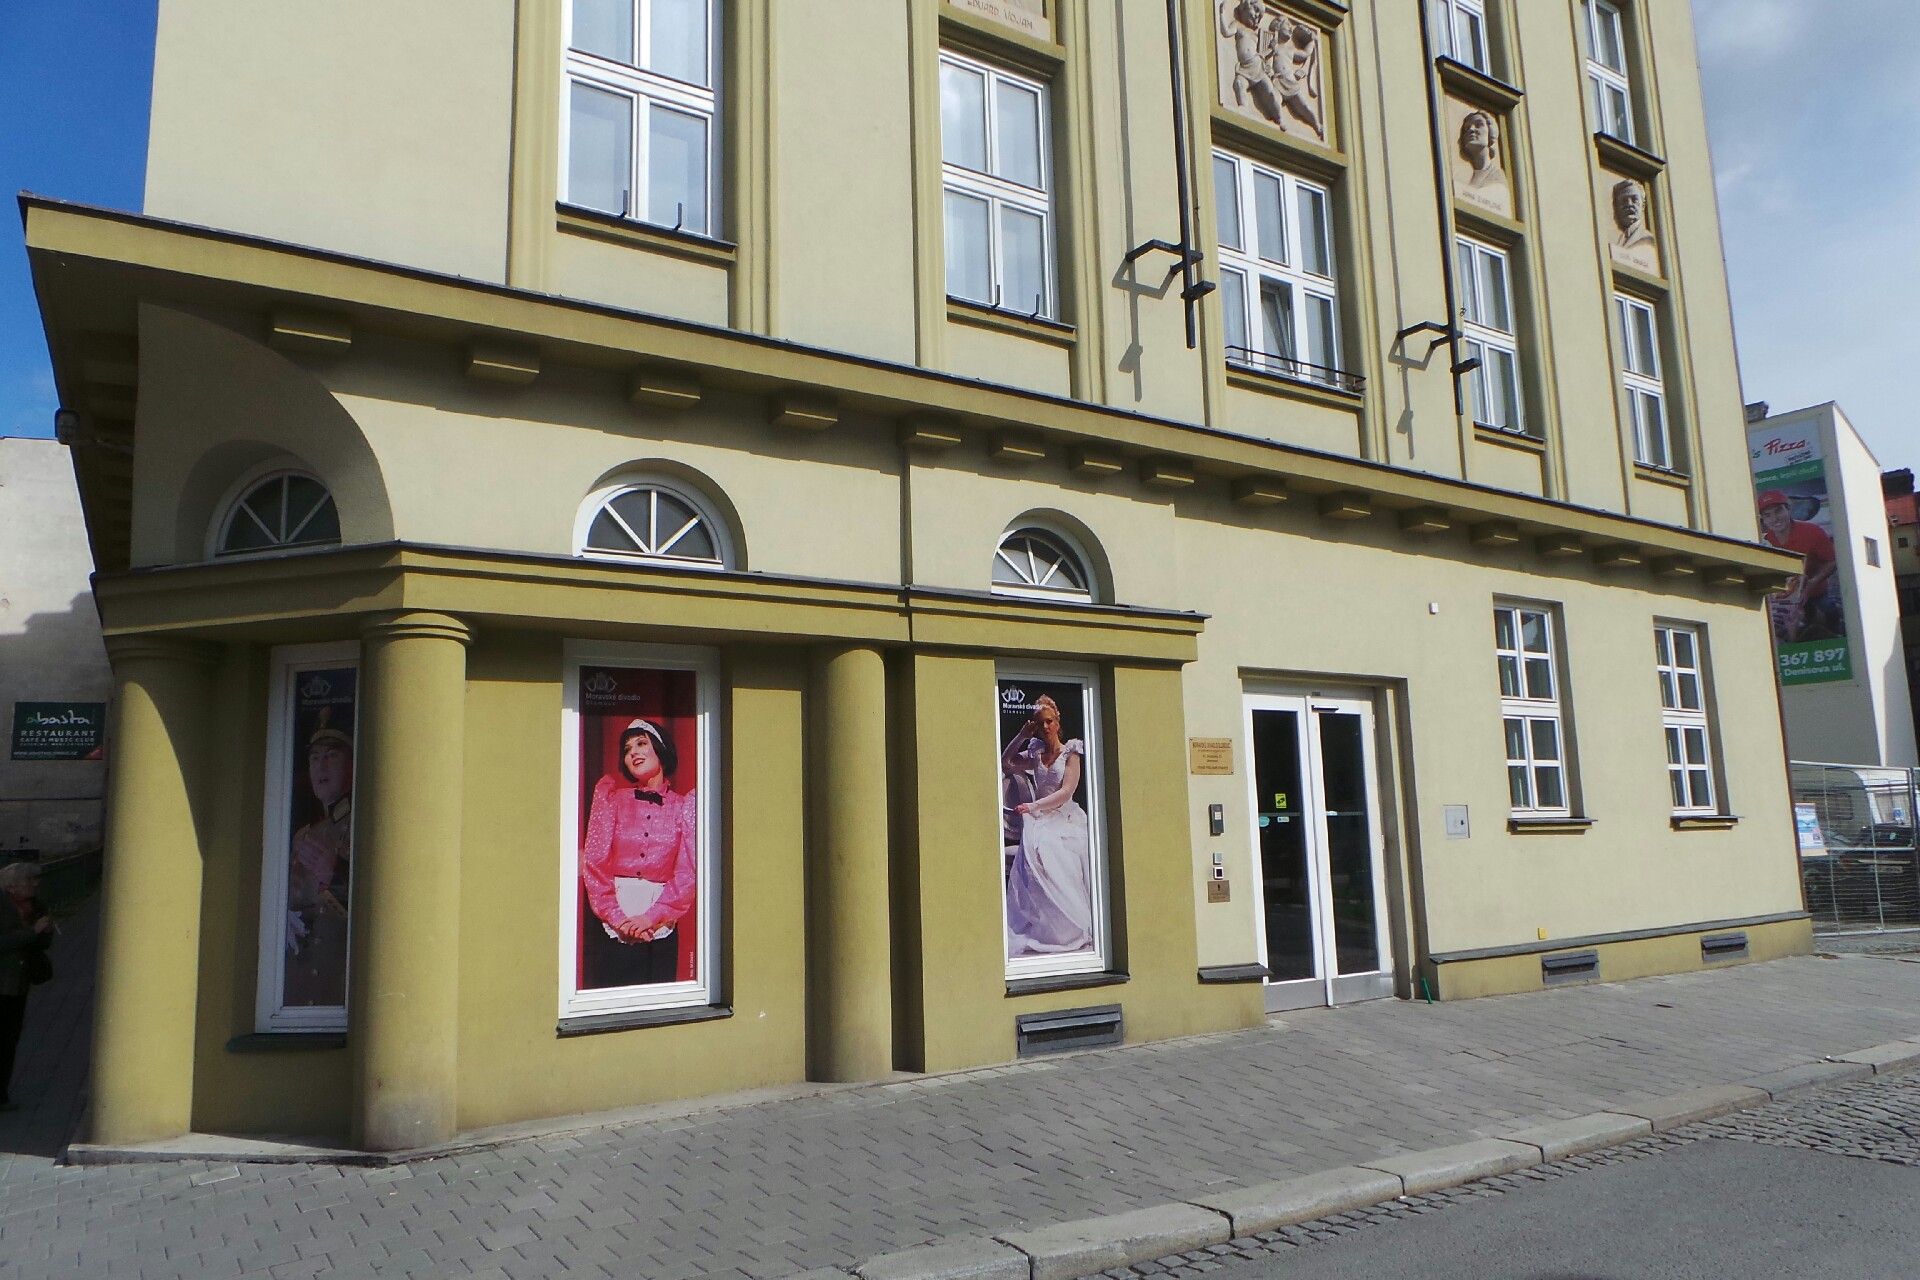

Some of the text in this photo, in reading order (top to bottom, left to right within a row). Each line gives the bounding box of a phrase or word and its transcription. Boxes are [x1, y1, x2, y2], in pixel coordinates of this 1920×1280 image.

[1763, 438, 1806, 455] Pizza
[1780, 648, 1845, 666] 367 897
[1784, 666, 1830, 676] Denisova
